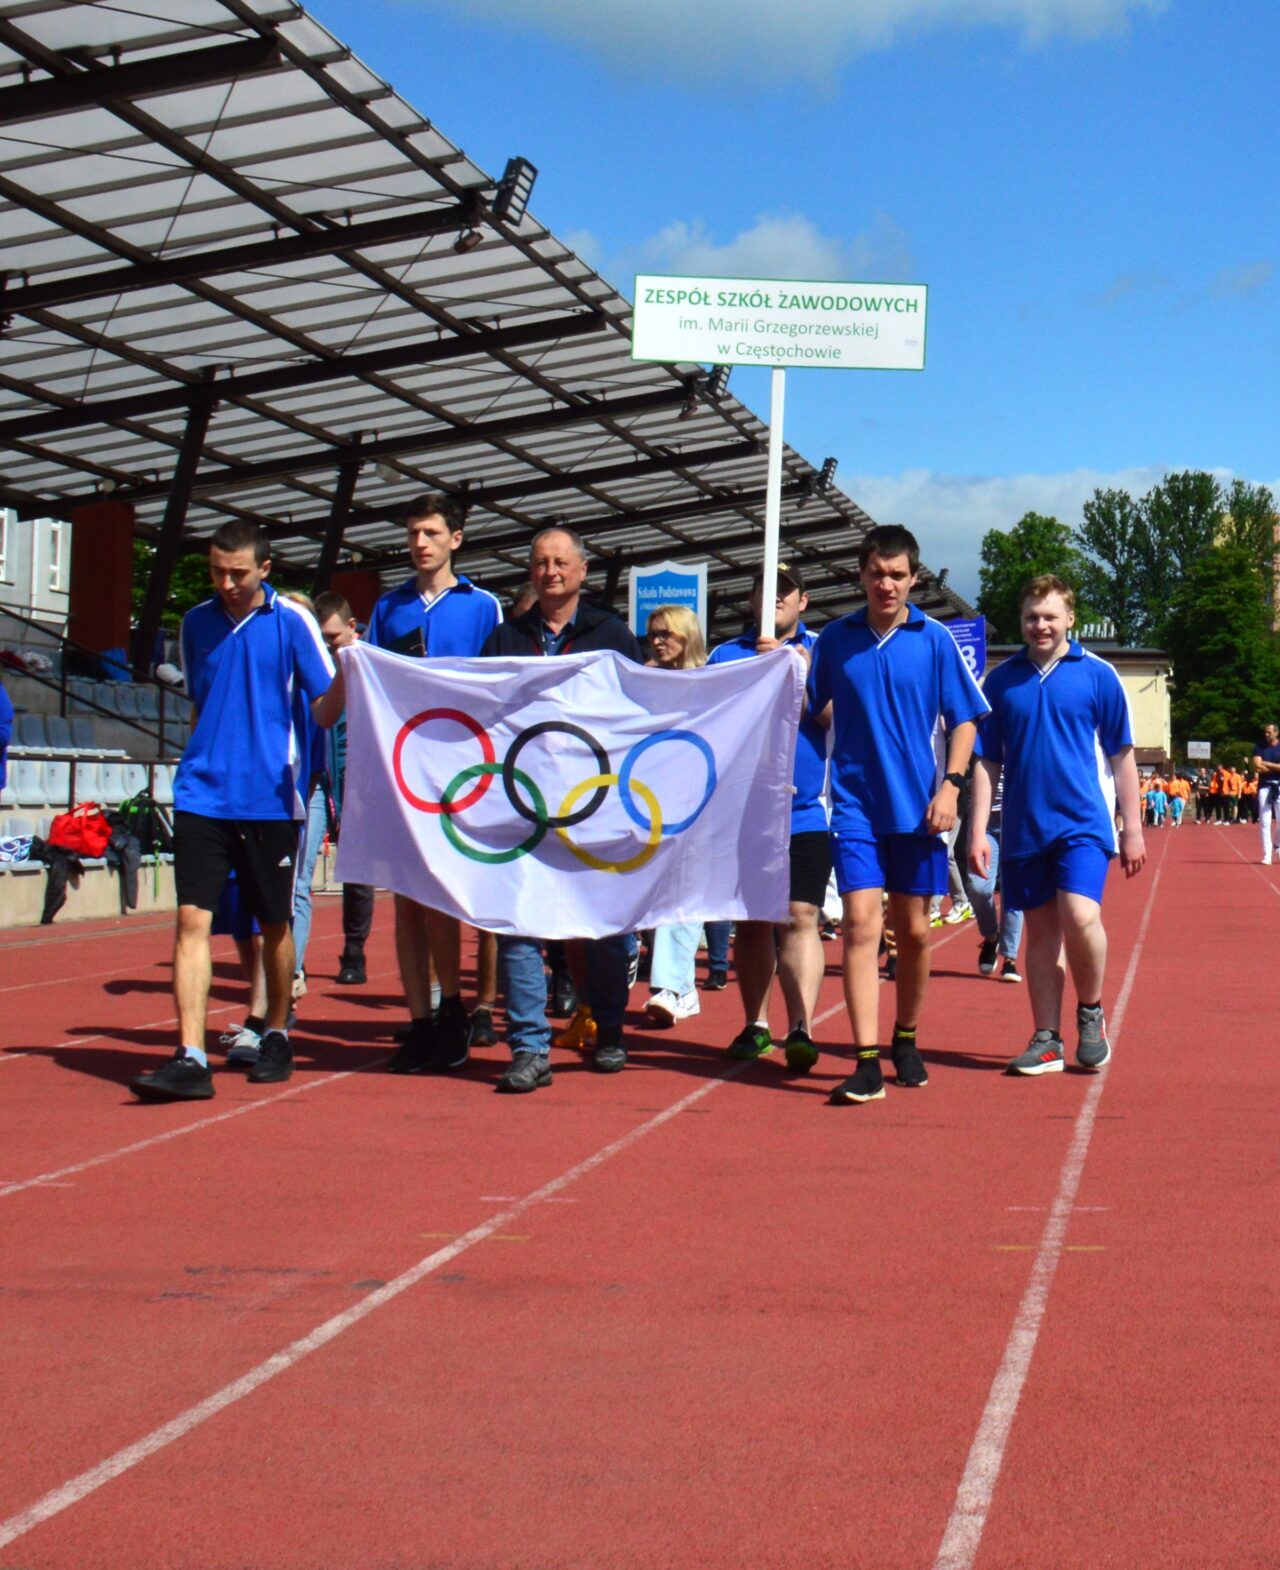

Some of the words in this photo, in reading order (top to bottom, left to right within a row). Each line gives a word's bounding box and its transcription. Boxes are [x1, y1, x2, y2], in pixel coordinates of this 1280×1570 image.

[644, 287, 712, 306] ZESPÓŁ
[717, 290, 773, 309] SZKÓŁ
[778, 293, 918, 313] ZAWODOWYCH
[678, 316, 703, 331] im.
[708, 317, 749, 333] Marii
[753, 319, 879, 340] Grzegorzewskiej
[717, 343, 731, 355] w
[735, 342, 842, 360] Częstochowie
